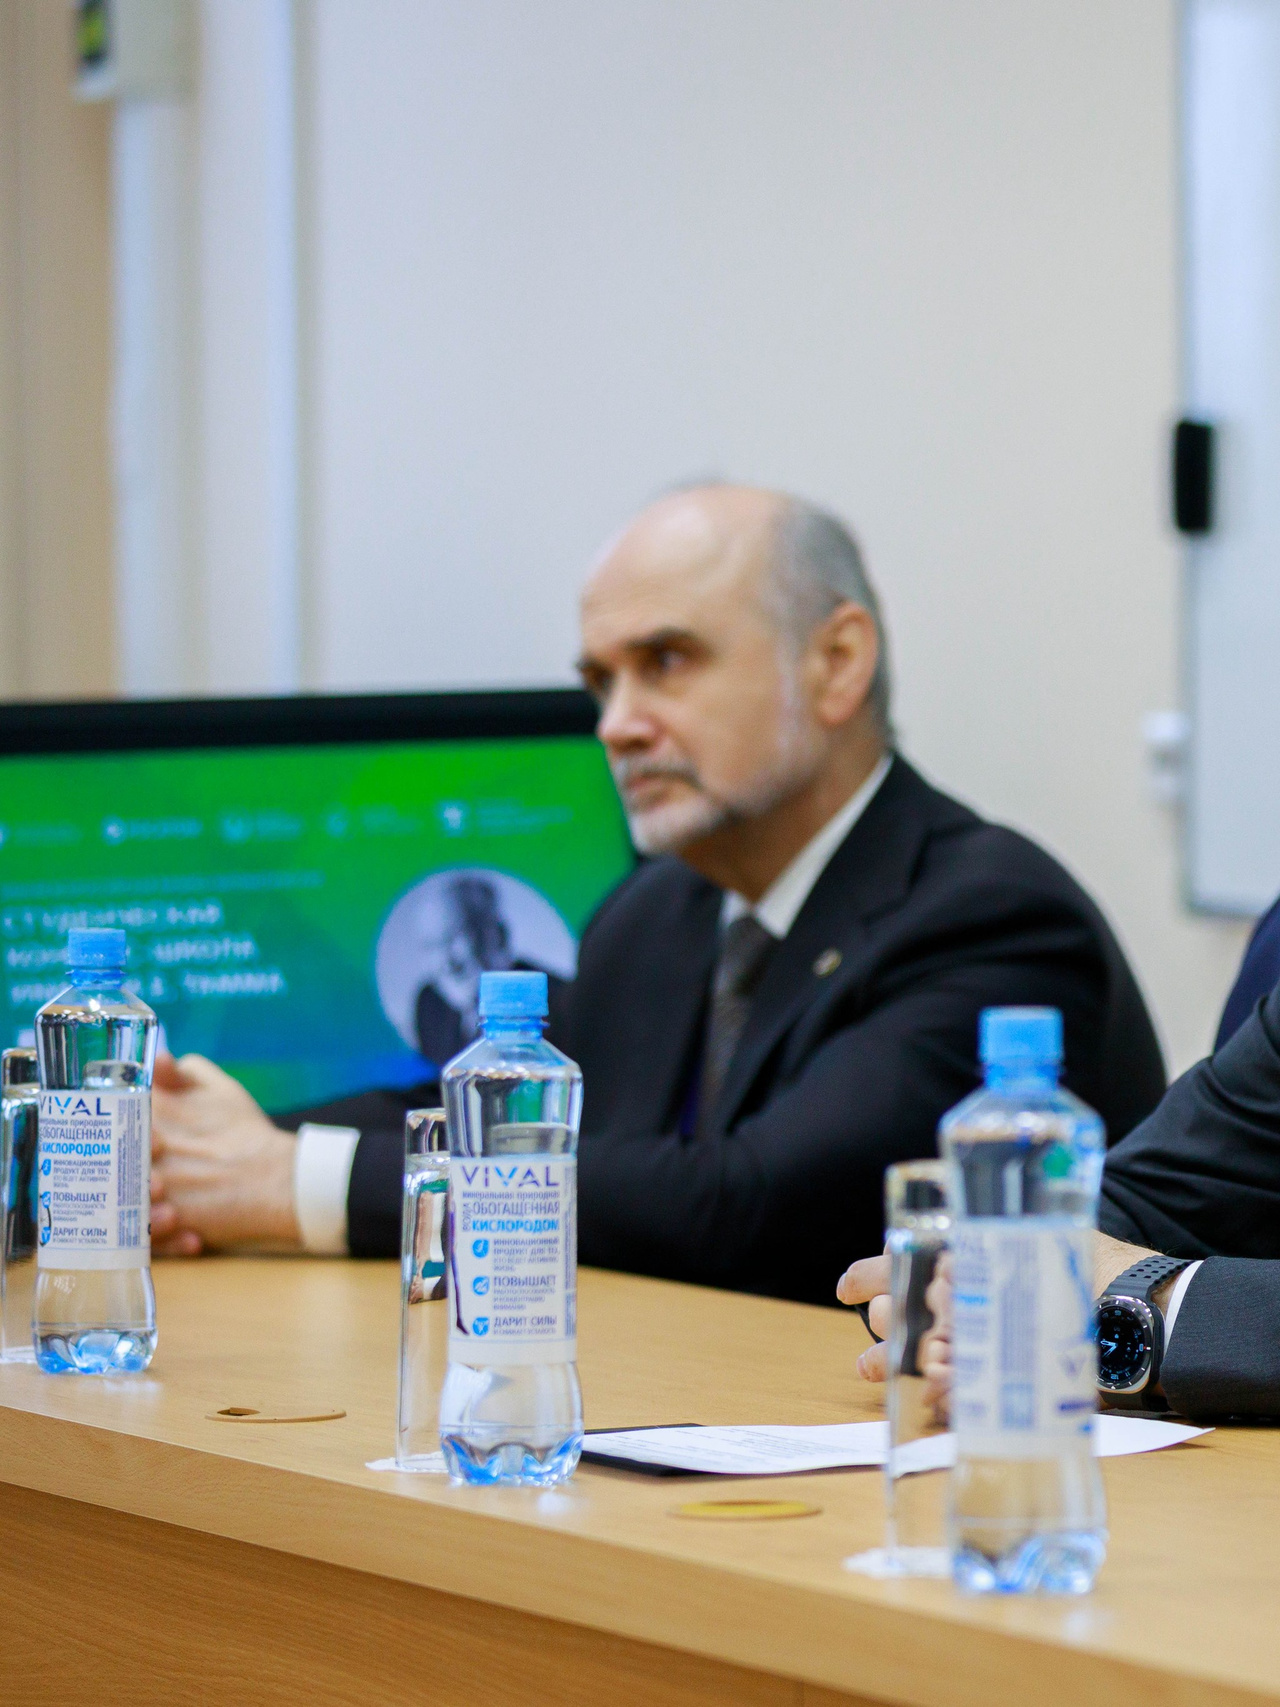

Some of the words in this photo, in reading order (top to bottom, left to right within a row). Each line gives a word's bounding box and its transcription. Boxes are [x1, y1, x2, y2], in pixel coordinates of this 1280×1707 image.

[40, 1096, 112, 1116] VIVAL
[461, 1165, 559, 1187] VIVAL
[472, 1219, 559, 1233] КИСЛОРОДОМ
